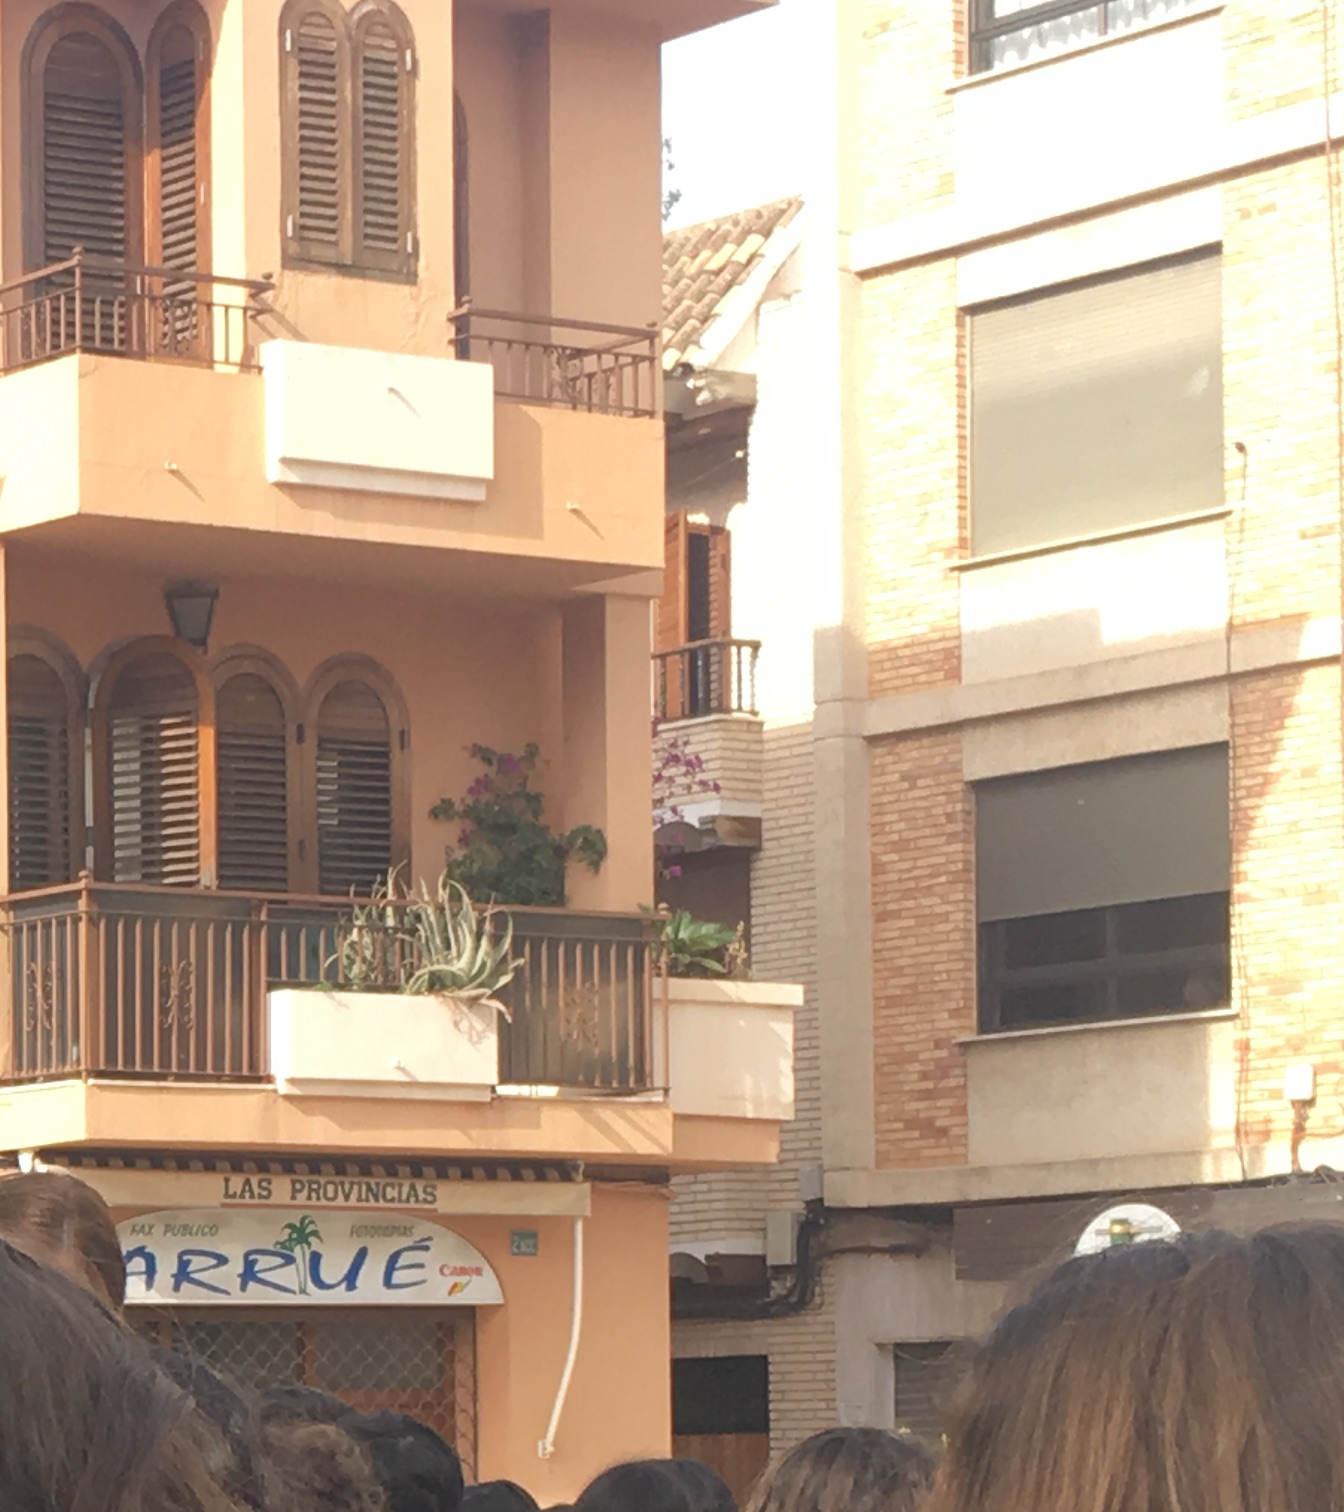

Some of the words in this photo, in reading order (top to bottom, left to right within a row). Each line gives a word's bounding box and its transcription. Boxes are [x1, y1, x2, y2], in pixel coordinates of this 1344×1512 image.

[223, 1176, 272, 1200] LAS
[290, 1178, 437, 1205] PROVINCIAS
[163, 1223, 219, 1237] PUBLICO
